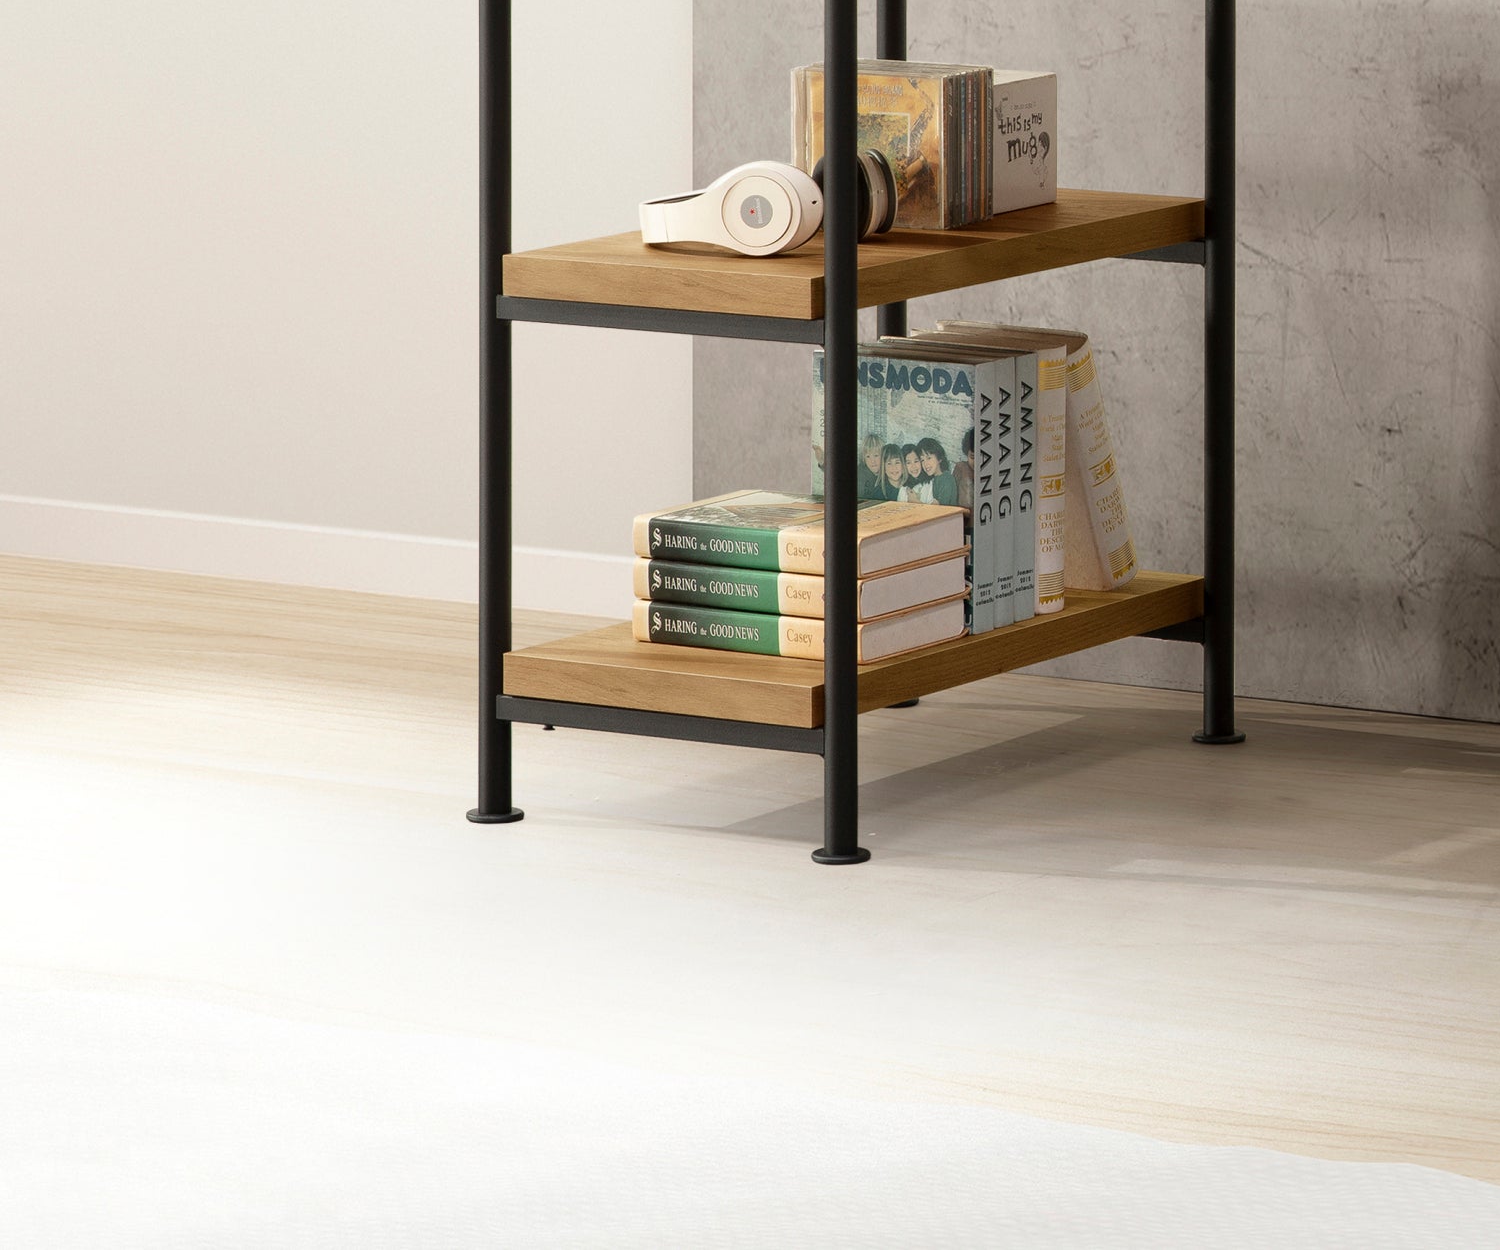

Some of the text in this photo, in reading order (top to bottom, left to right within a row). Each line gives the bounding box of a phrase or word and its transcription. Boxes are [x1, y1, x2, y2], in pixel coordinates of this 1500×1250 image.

[998, 112, 1042, 135] this is my
[999, 386, 1012, 520] AMANG
[1020, 380, 1033, 513] AMANG
[980, 393, 992, 526] AMANG
[709, 538, 734, 553] GOOD
[735, 541, 759, 556] NEWS
[785, 542, 812, 561] Casey
[709, 580, 733, 596] GOOD
[735, 583, 759, 598] NEWS
[785, 585, 812, 604] Casey
[709, 623, 734, 639] GOOD
[735, 626, 759, 642] NEWS
[786, 628, 813, 647] Casey
